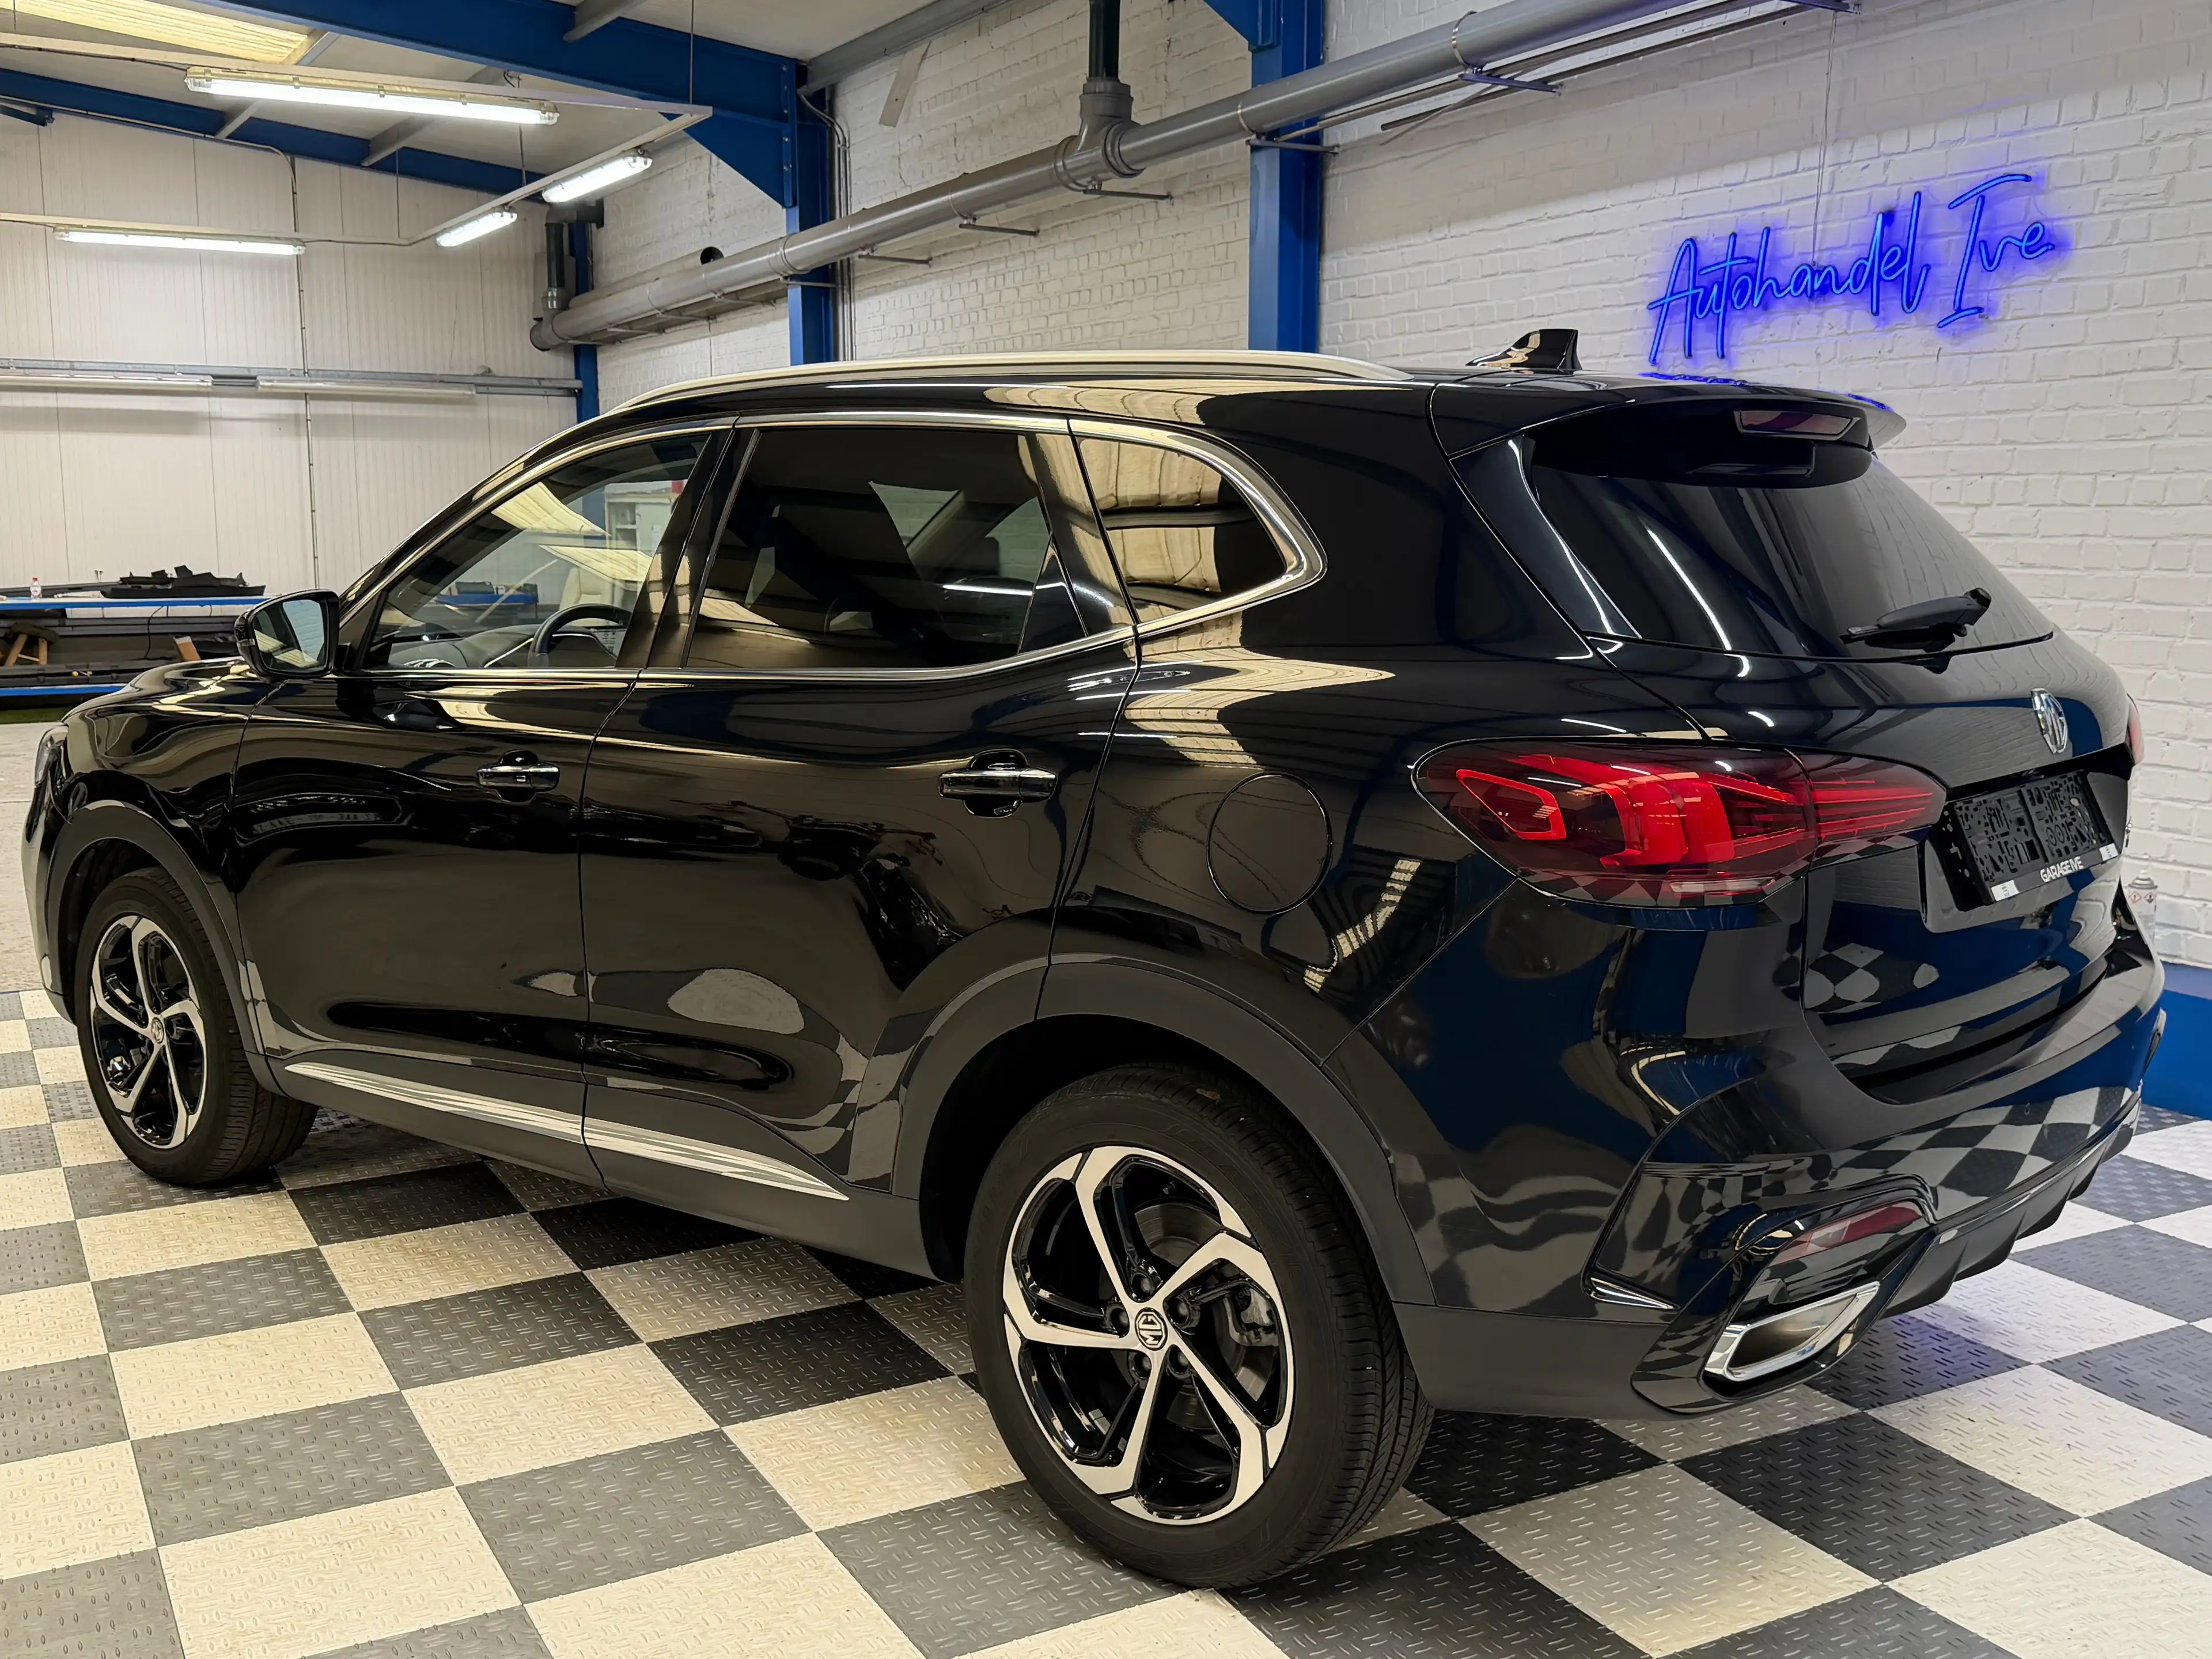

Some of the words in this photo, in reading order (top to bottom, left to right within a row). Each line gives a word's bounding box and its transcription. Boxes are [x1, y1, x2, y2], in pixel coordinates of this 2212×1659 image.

[1647, 191, 1930, 366] Autohandel
[1937, 173, 2055, 328] Ive
[2040, 860, 2072, 882] GARAGE
[1139, 1315, 1163, 1344] MG
